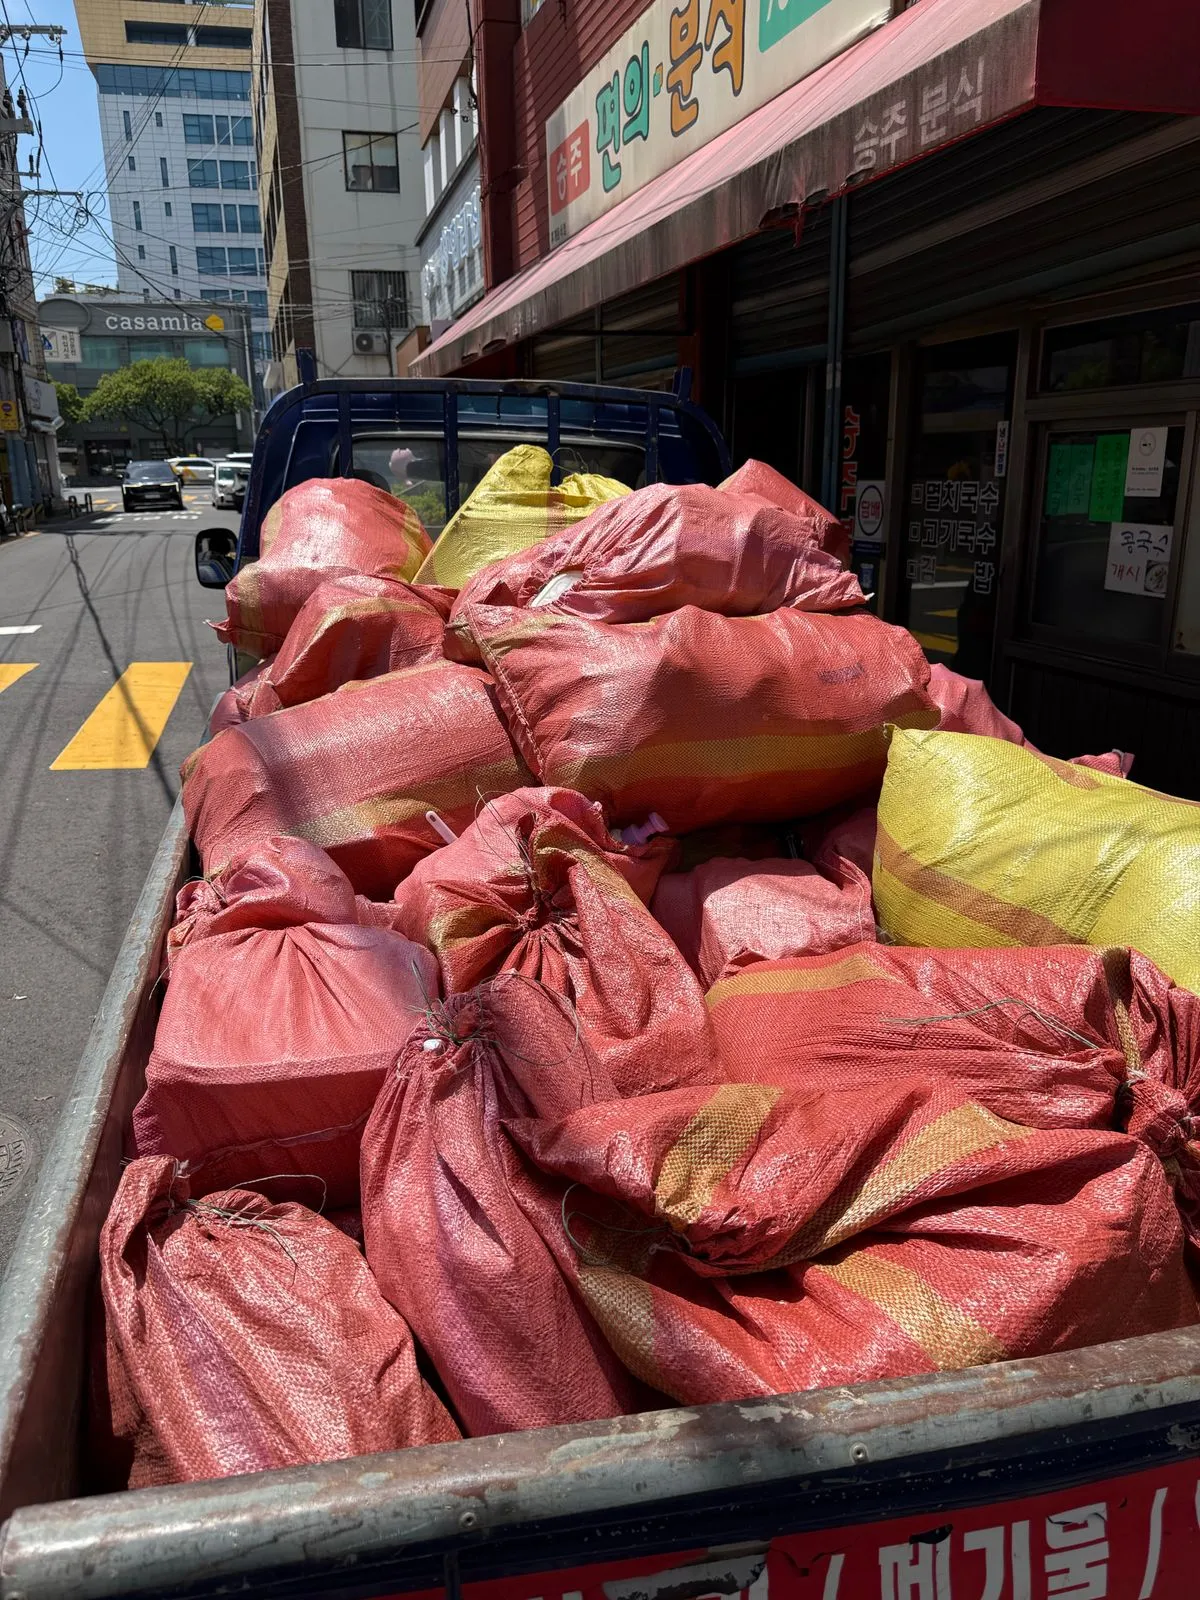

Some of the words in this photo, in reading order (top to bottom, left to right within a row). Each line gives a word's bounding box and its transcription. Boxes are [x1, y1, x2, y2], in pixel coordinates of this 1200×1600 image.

[852, 99, 908, 172] 승주
[919, 56, 985, 146] 분식
[556, 136, 582, 201] 승주
[105, 313, 204, 331] casamia
[861, 500, 880, 519] 담배
[925, 480, 999, 514] 멸치국수
[921, 518, 996, 554] 고기국수
[1121, 530, 1168, 556] 콩국수
[1112, 563, 1140, 582] 개시
